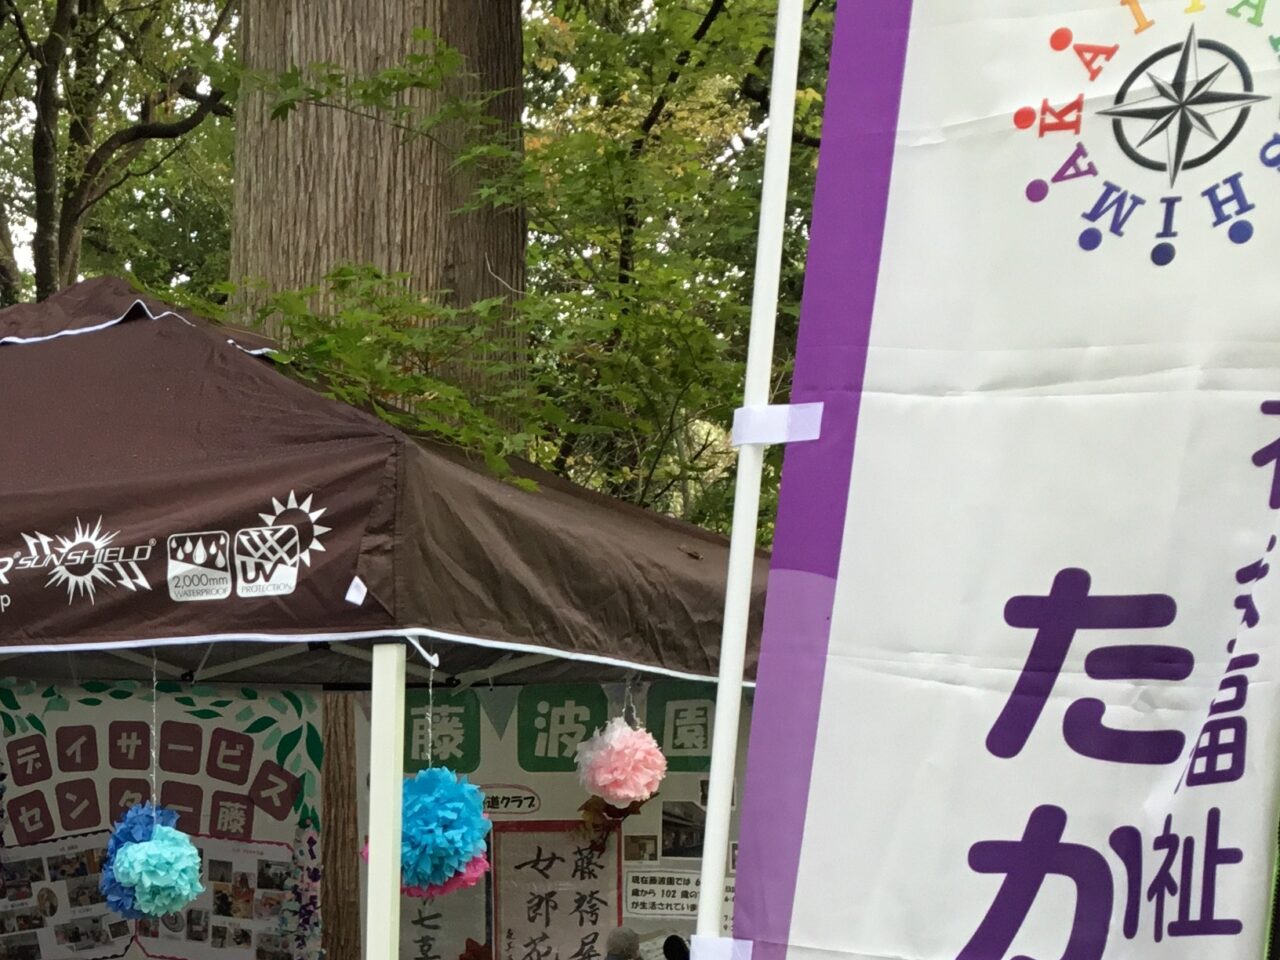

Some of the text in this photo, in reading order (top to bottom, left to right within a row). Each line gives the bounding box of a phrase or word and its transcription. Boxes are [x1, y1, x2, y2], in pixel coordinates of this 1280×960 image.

[16, 544, 152, 571] SUNSHIELD
[172, 573, 229, 589] 2,000mm
[239, 559, 278, 584] UV
[172, 585, 229, 598] WATERPROOF
[240, 582, 293, 594] PROTECTION
[410, 699, 715, 762] 藤波園
[15, 728, 292, 808] デイサービス
[18, 786, 246, 834] センター藤
[483, 794, 536, 810] 道クラブ
[661, 889, 677, 899] 102
[680, 889, 700, 899] 歳の
